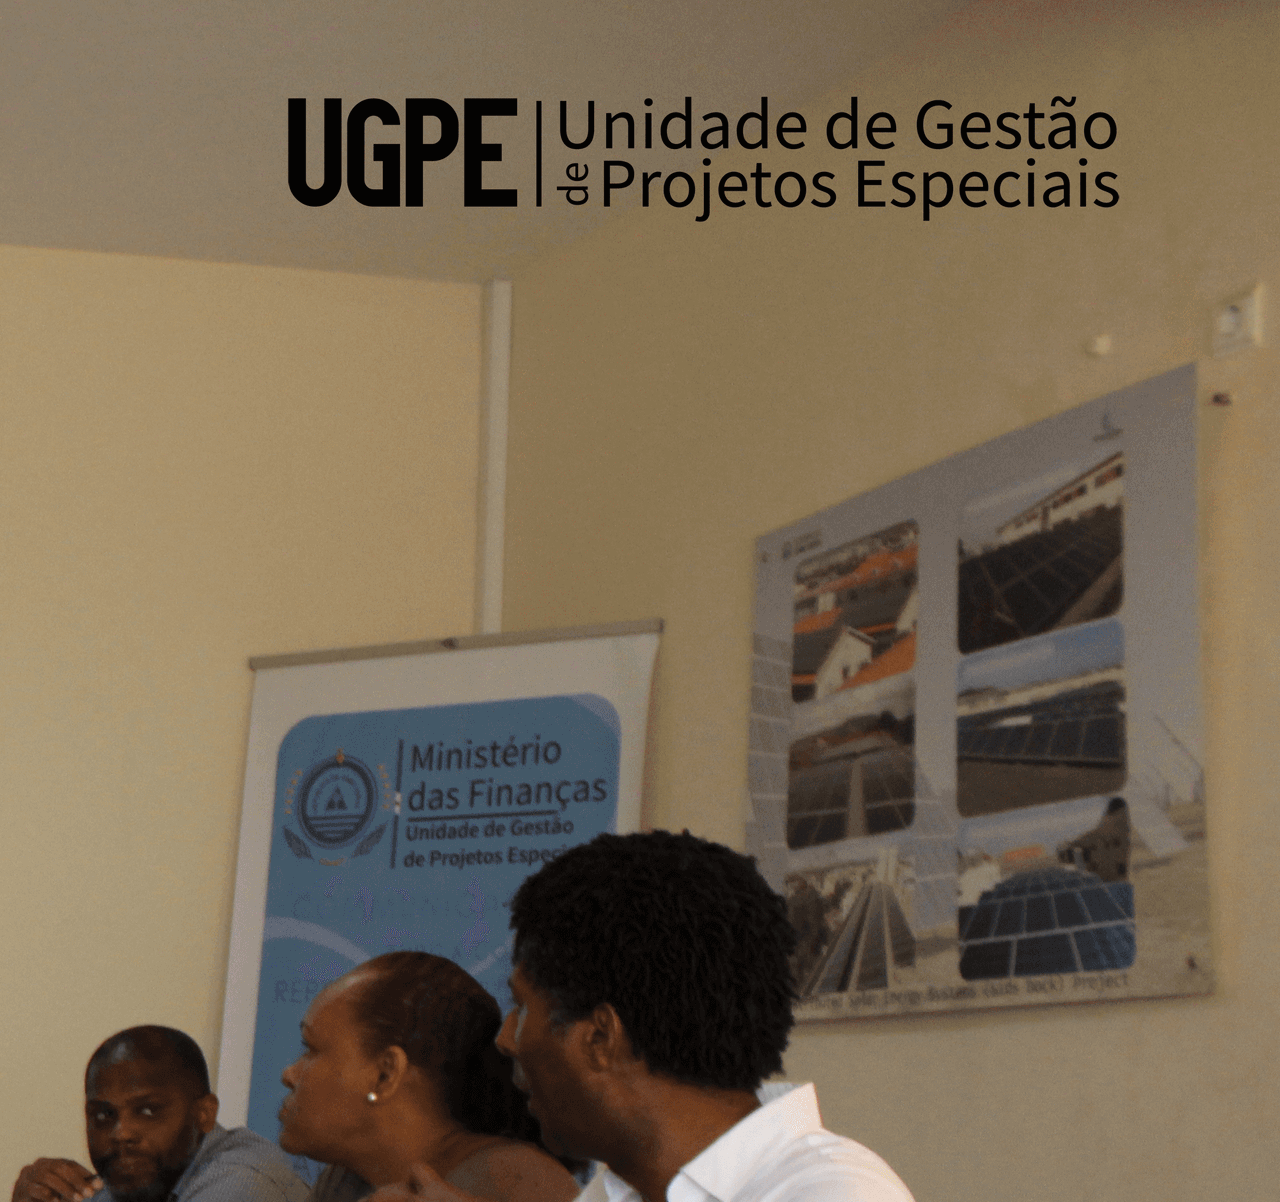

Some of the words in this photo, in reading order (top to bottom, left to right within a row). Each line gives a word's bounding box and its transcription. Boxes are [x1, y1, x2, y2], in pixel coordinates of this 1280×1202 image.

[410, 734, 562, 772] Ministério
[407, 781, 460, 812] das
[469, 777, 608, 811] Finanças
[405, 822, 479, 841] Unidade
[483, 820, 506, 838] de
[510, 816, 575, 836] Gestão
[403, 851, 425, 868] de
[429, 847, 503, 870] Projetos
[507, 846, 564, 867] Espec
